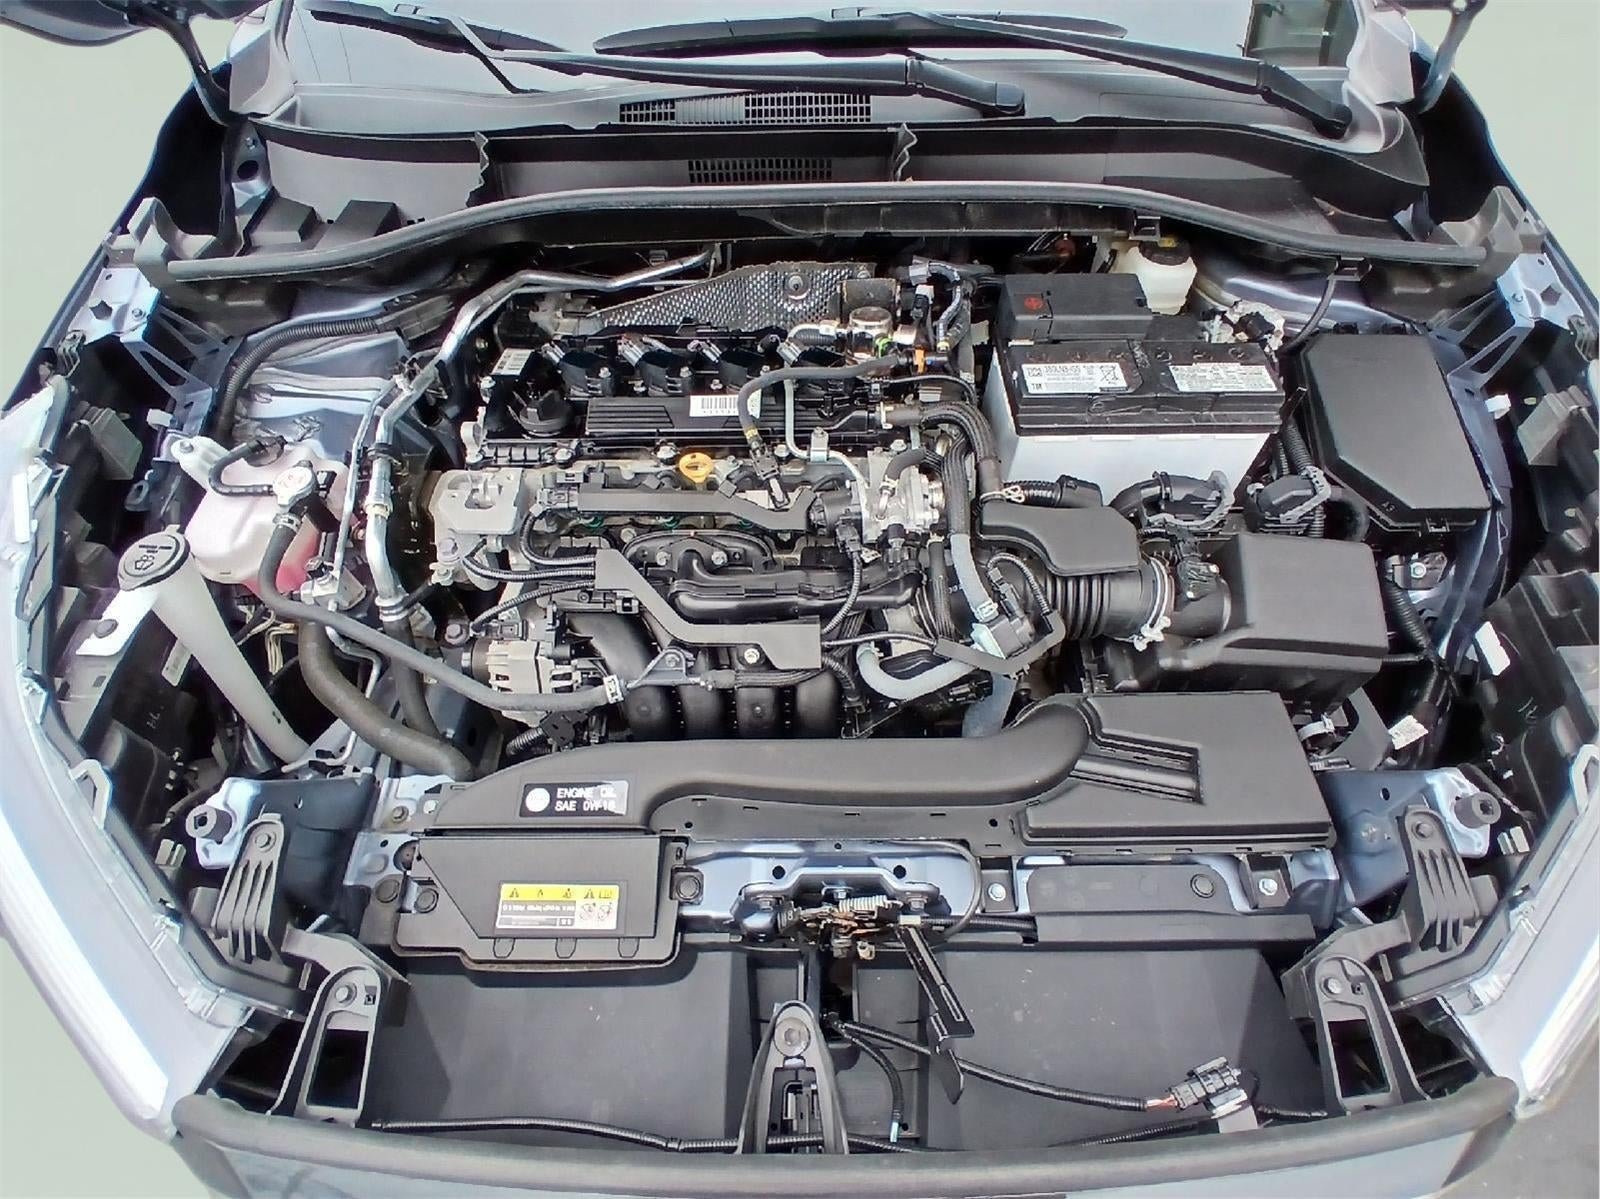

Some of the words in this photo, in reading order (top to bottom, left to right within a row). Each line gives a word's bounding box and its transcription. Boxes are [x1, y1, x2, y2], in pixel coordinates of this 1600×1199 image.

[556, 787, 594, 799] ENGINE
[600, 787, 617, 798] OIL
[555, 800, 578, 812] SAE
